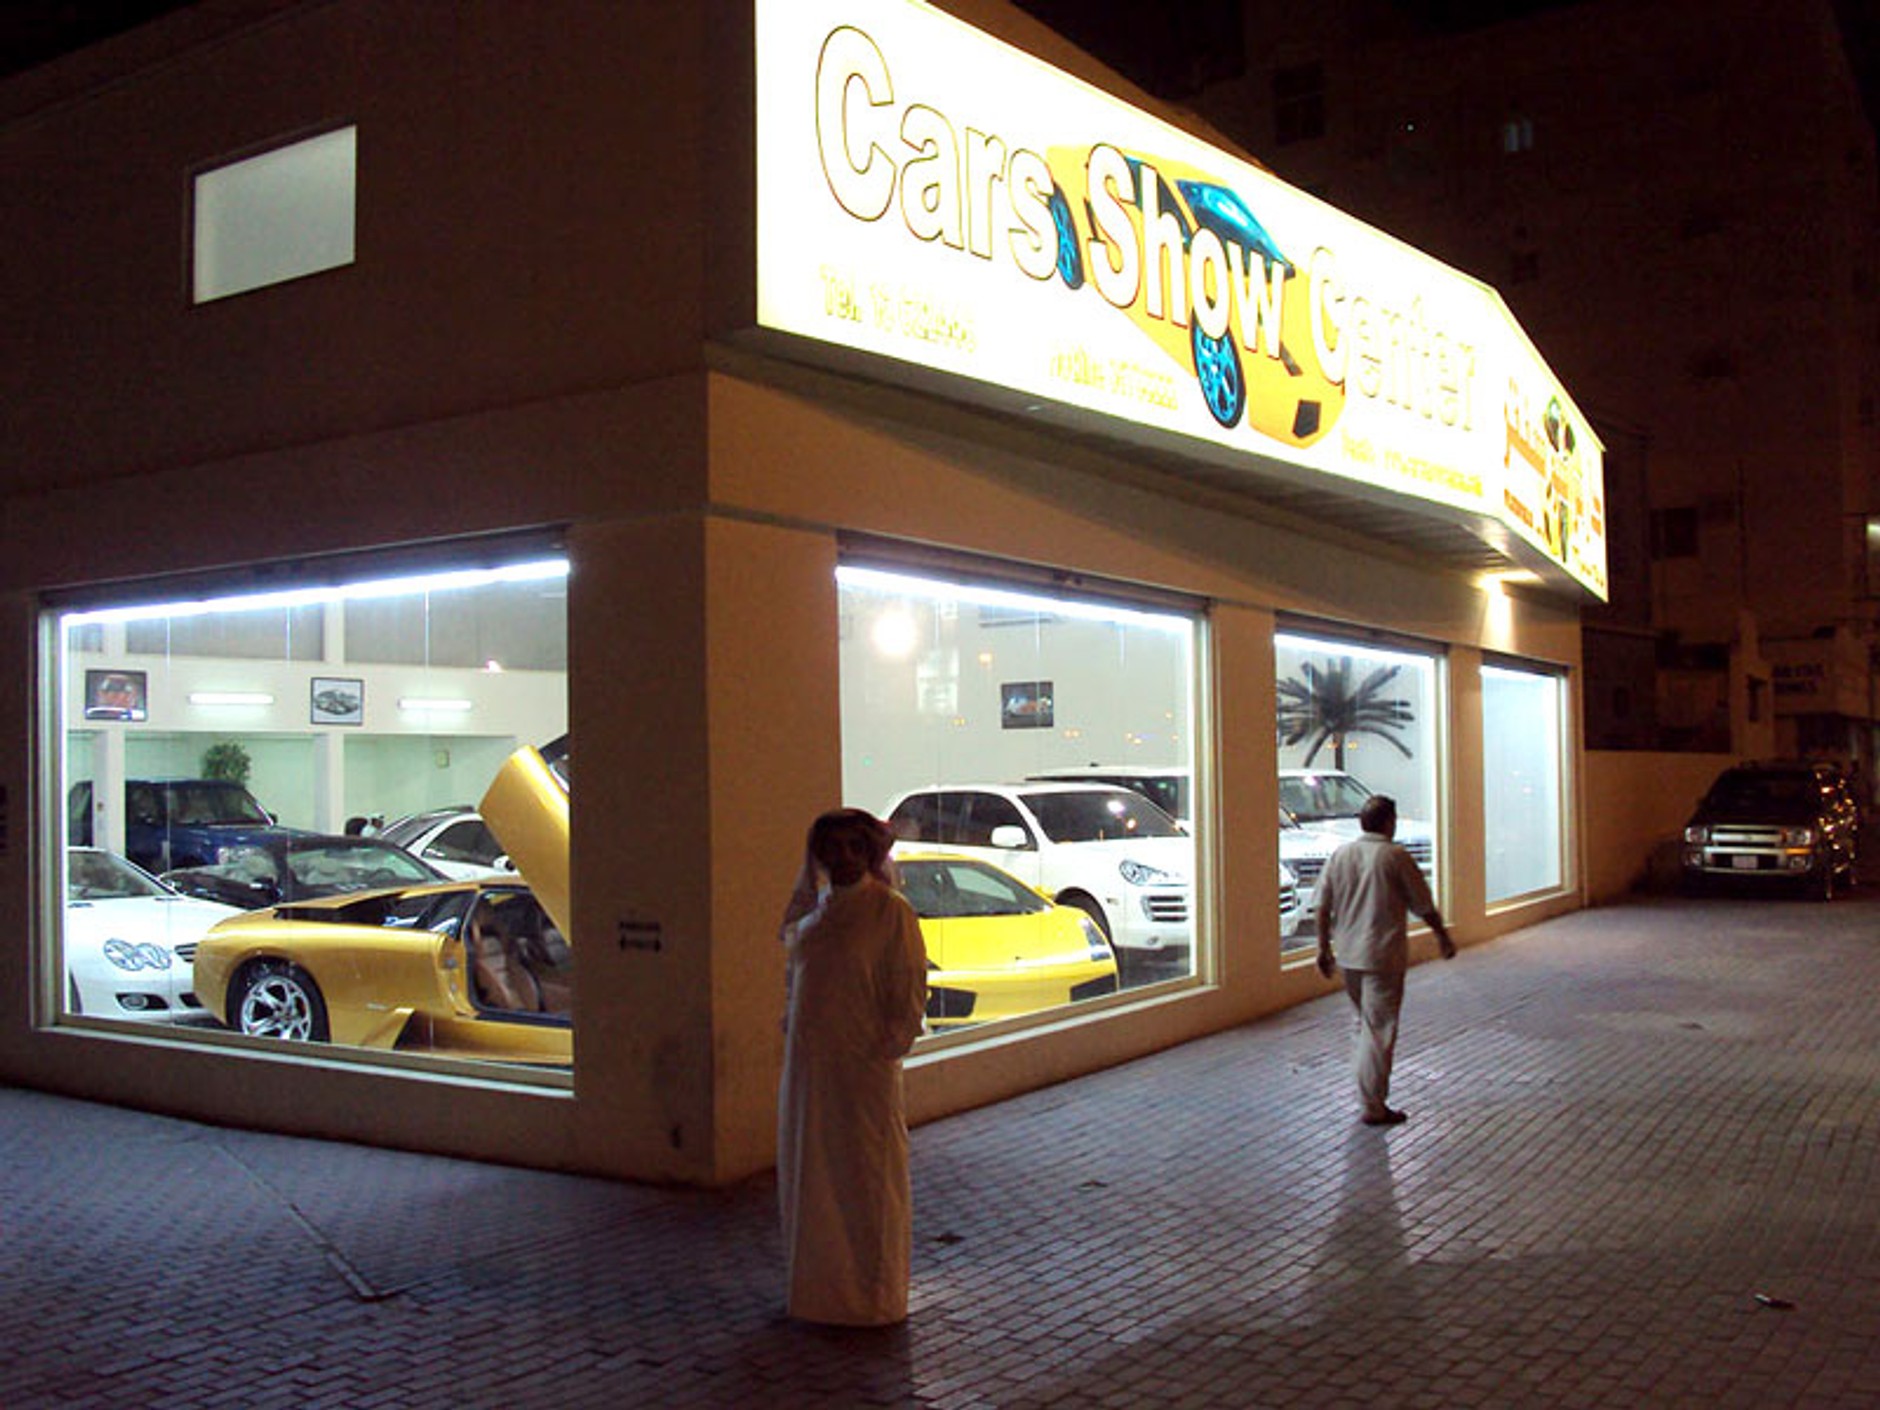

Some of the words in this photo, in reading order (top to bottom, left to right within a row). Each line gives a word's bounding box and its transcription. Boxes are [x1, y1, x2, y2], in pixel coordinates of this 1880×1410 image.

[815, 25, 1060, 281] Cars
[1086, 142, 1287, 361] Show
[1309, 245, 1477, 432] Center
